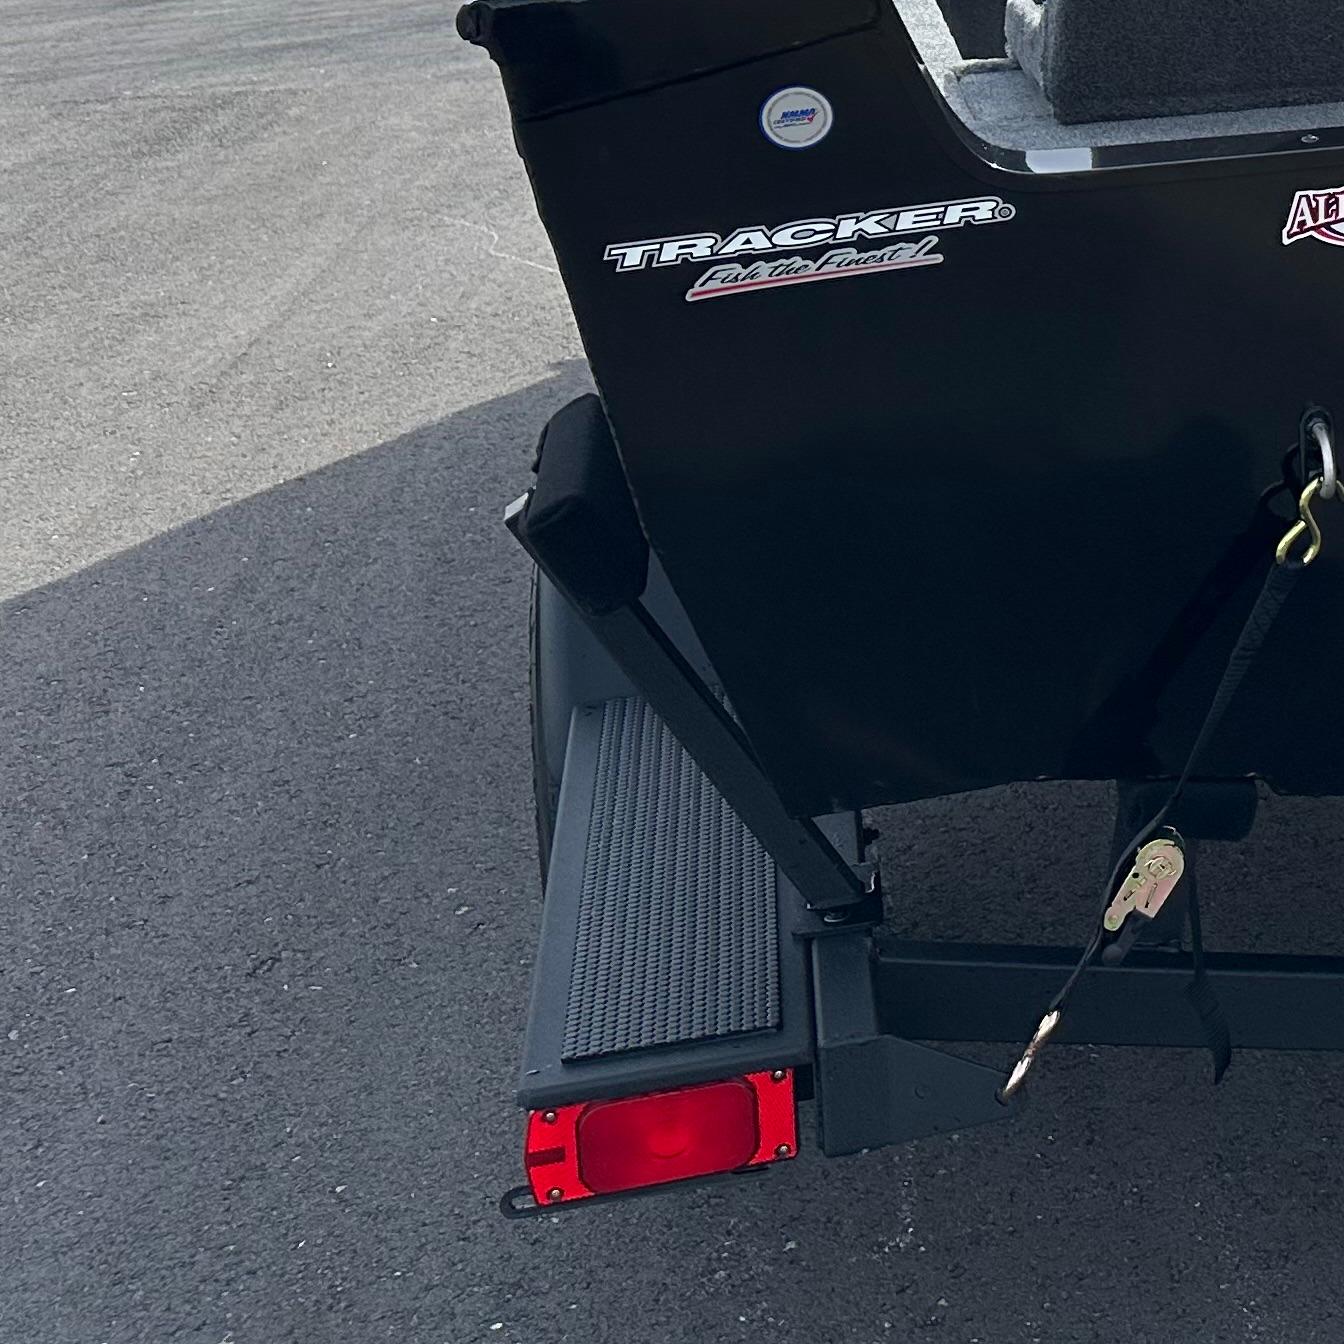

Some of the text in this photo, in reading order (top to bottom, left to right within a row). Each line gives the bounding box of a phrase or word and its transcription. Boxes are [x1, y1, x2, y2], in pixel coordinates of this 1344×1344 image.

[608, 199, 997, 270] TRACKER
[698, 265, 761, 288] Fish
[768, 259, 812, 279] the
